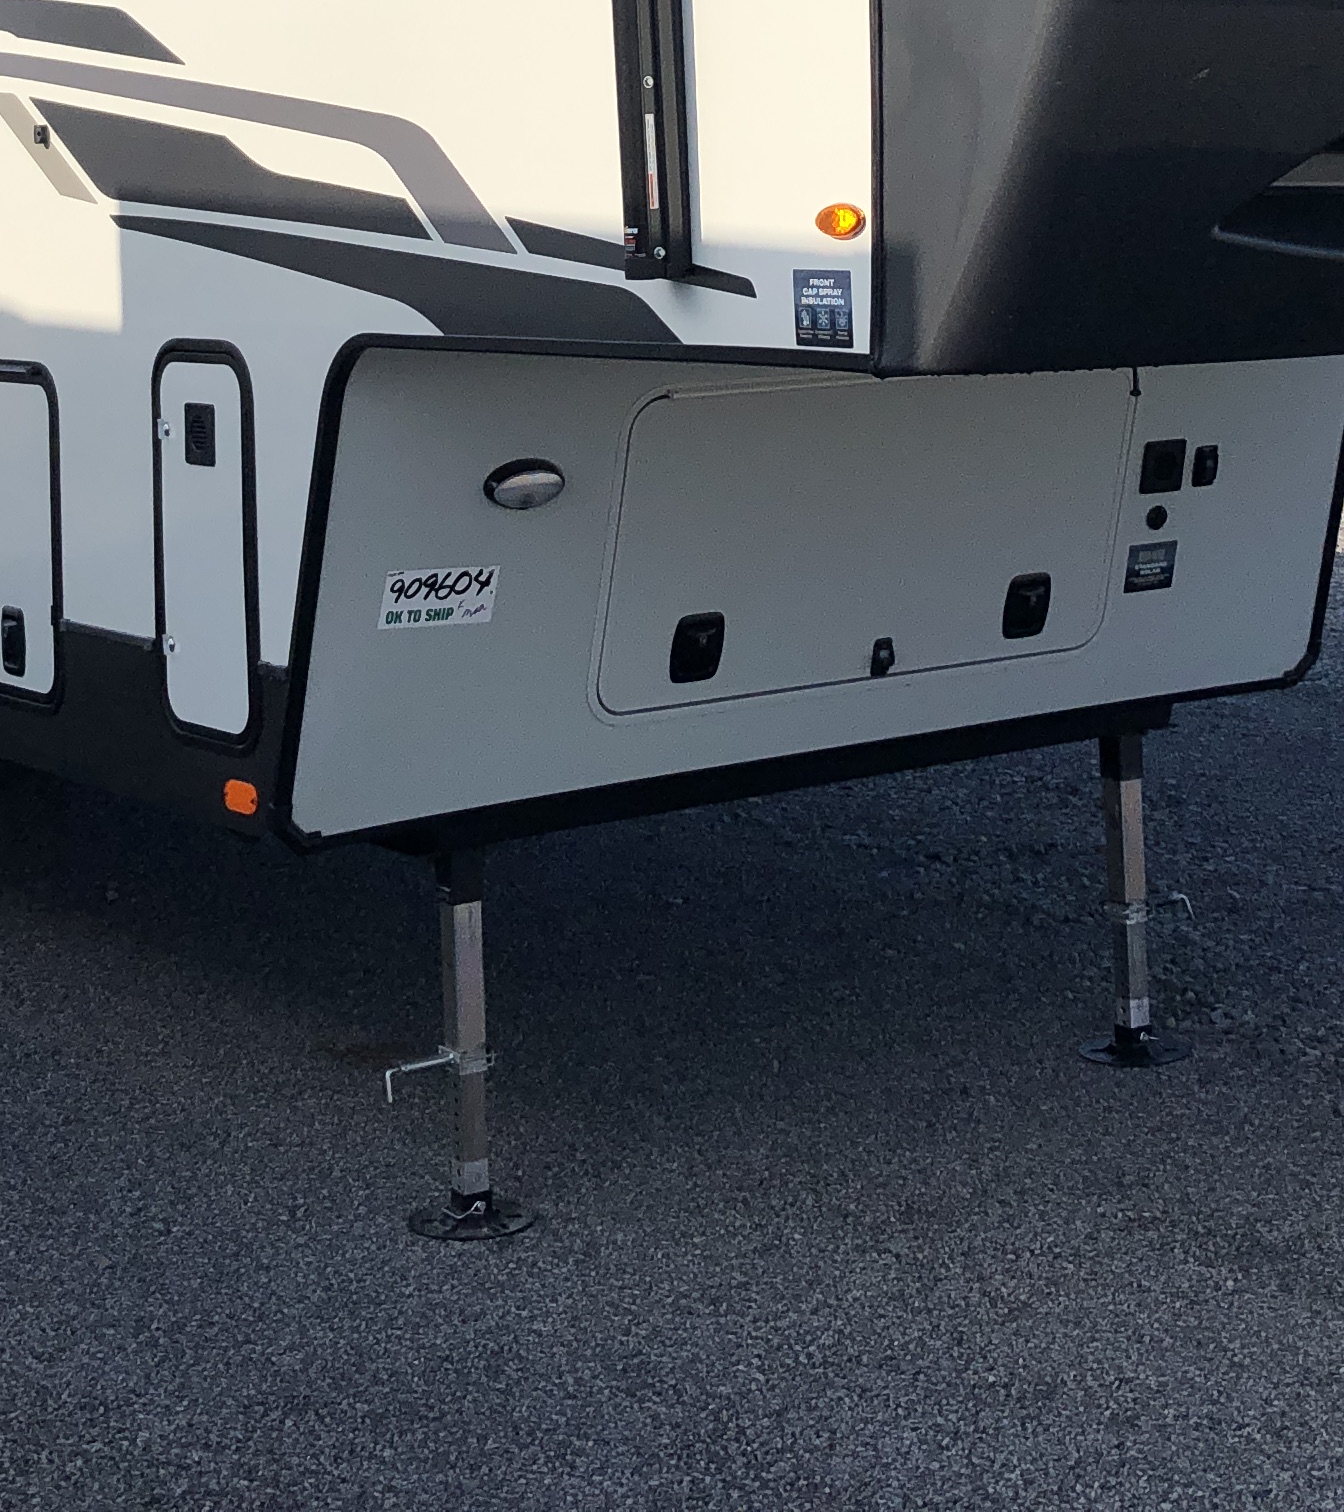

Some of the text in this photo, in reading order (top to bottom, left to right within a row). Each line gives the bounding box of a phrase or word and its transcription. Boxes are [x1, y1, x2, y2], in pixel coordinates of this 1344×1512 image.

[809, 278, 835, 287] FRONT
[802, 287, 843, 296] CAP SPRAY
[800, 296, 845, 306] INSULATION
[389, 568, 496, 604] 909604
[385, 609, 404, 625] OK
[406, 608, 422, 624] TO
[424, 606, 455, 622] SHIP
